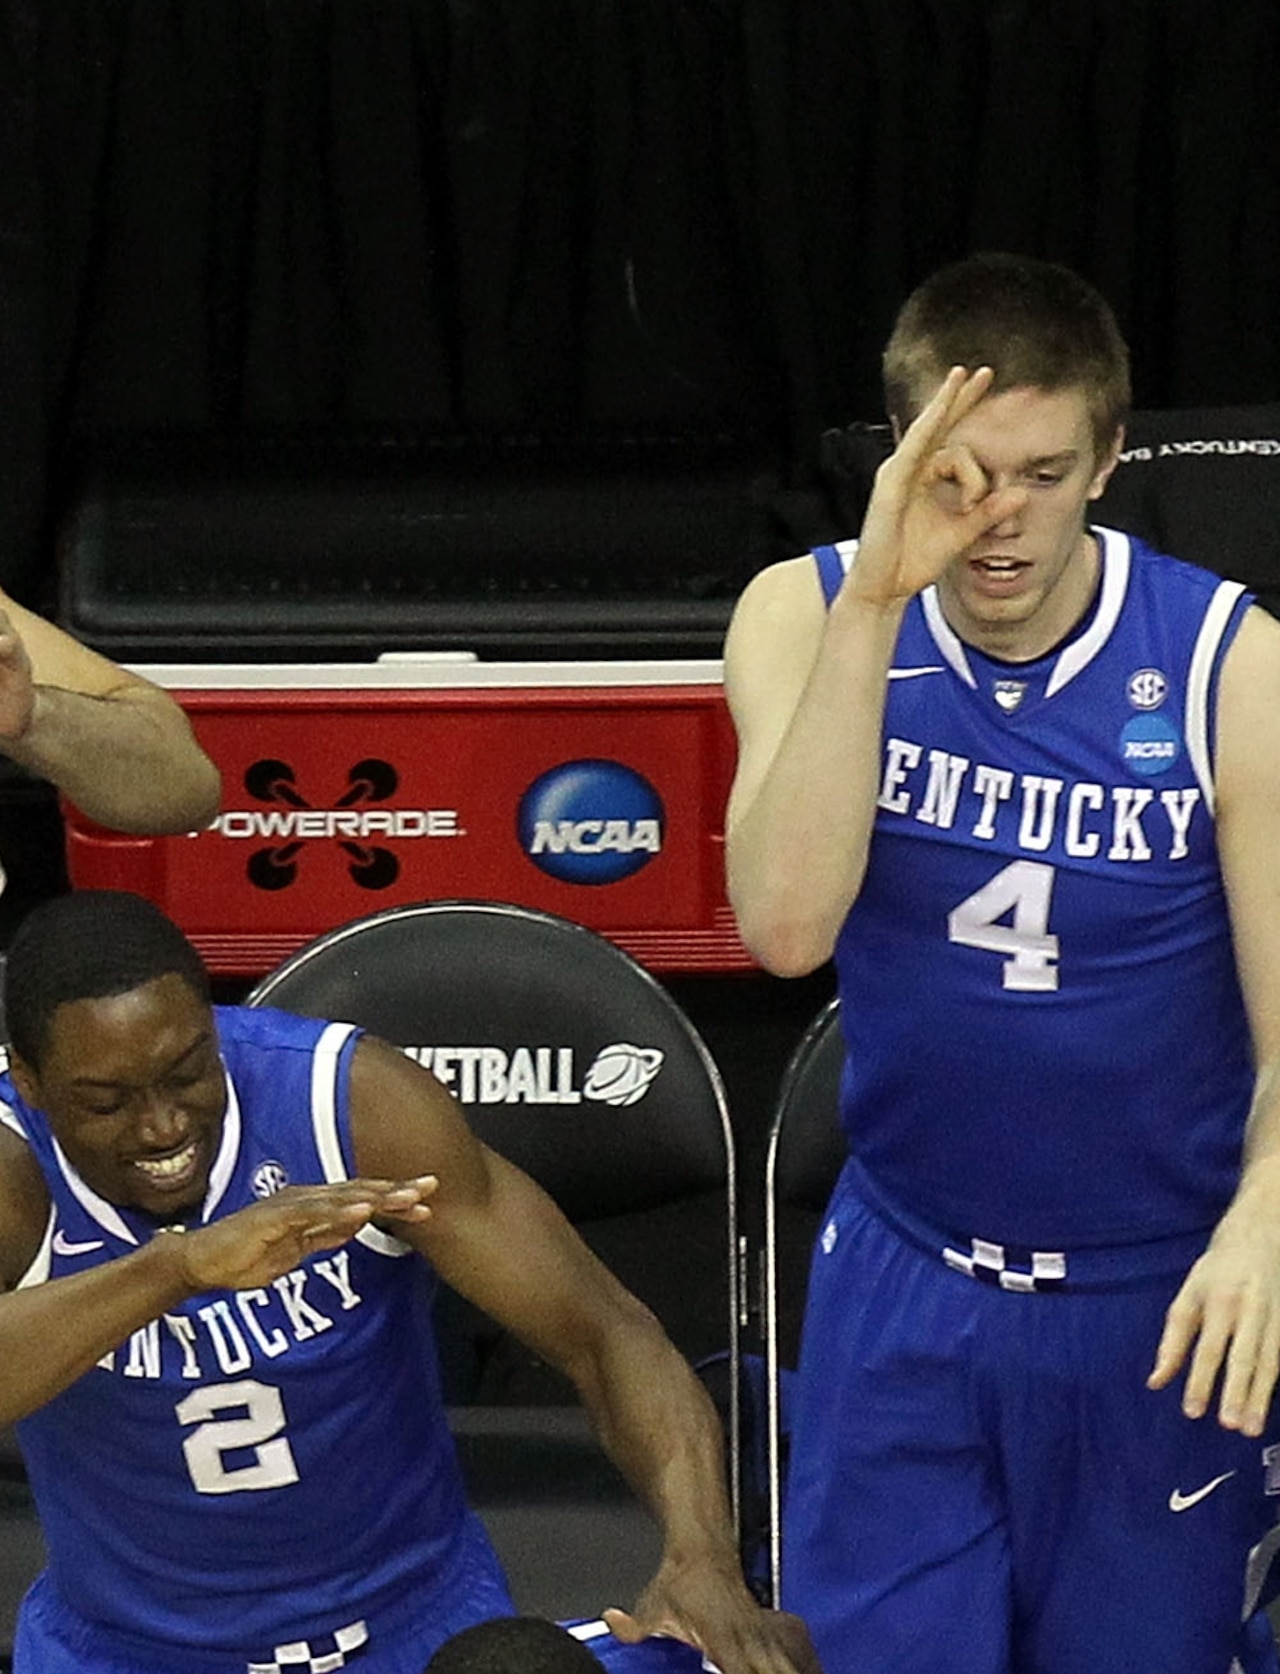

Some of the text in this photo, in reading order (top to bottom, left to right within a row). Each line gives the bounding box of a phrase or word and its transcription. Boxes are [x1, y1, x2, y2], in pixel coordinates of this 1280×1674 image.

[530, 819, 662, 855] NCAA
[876, 737, 1200, 862] ENTUCKY
[947, 858, 1060, 992] 4
[402, 1046, 581, 1105] ETBALL
[96, 1250, 363, 1379] NTUCKY
[174, 1378, 301, 1494] 2
